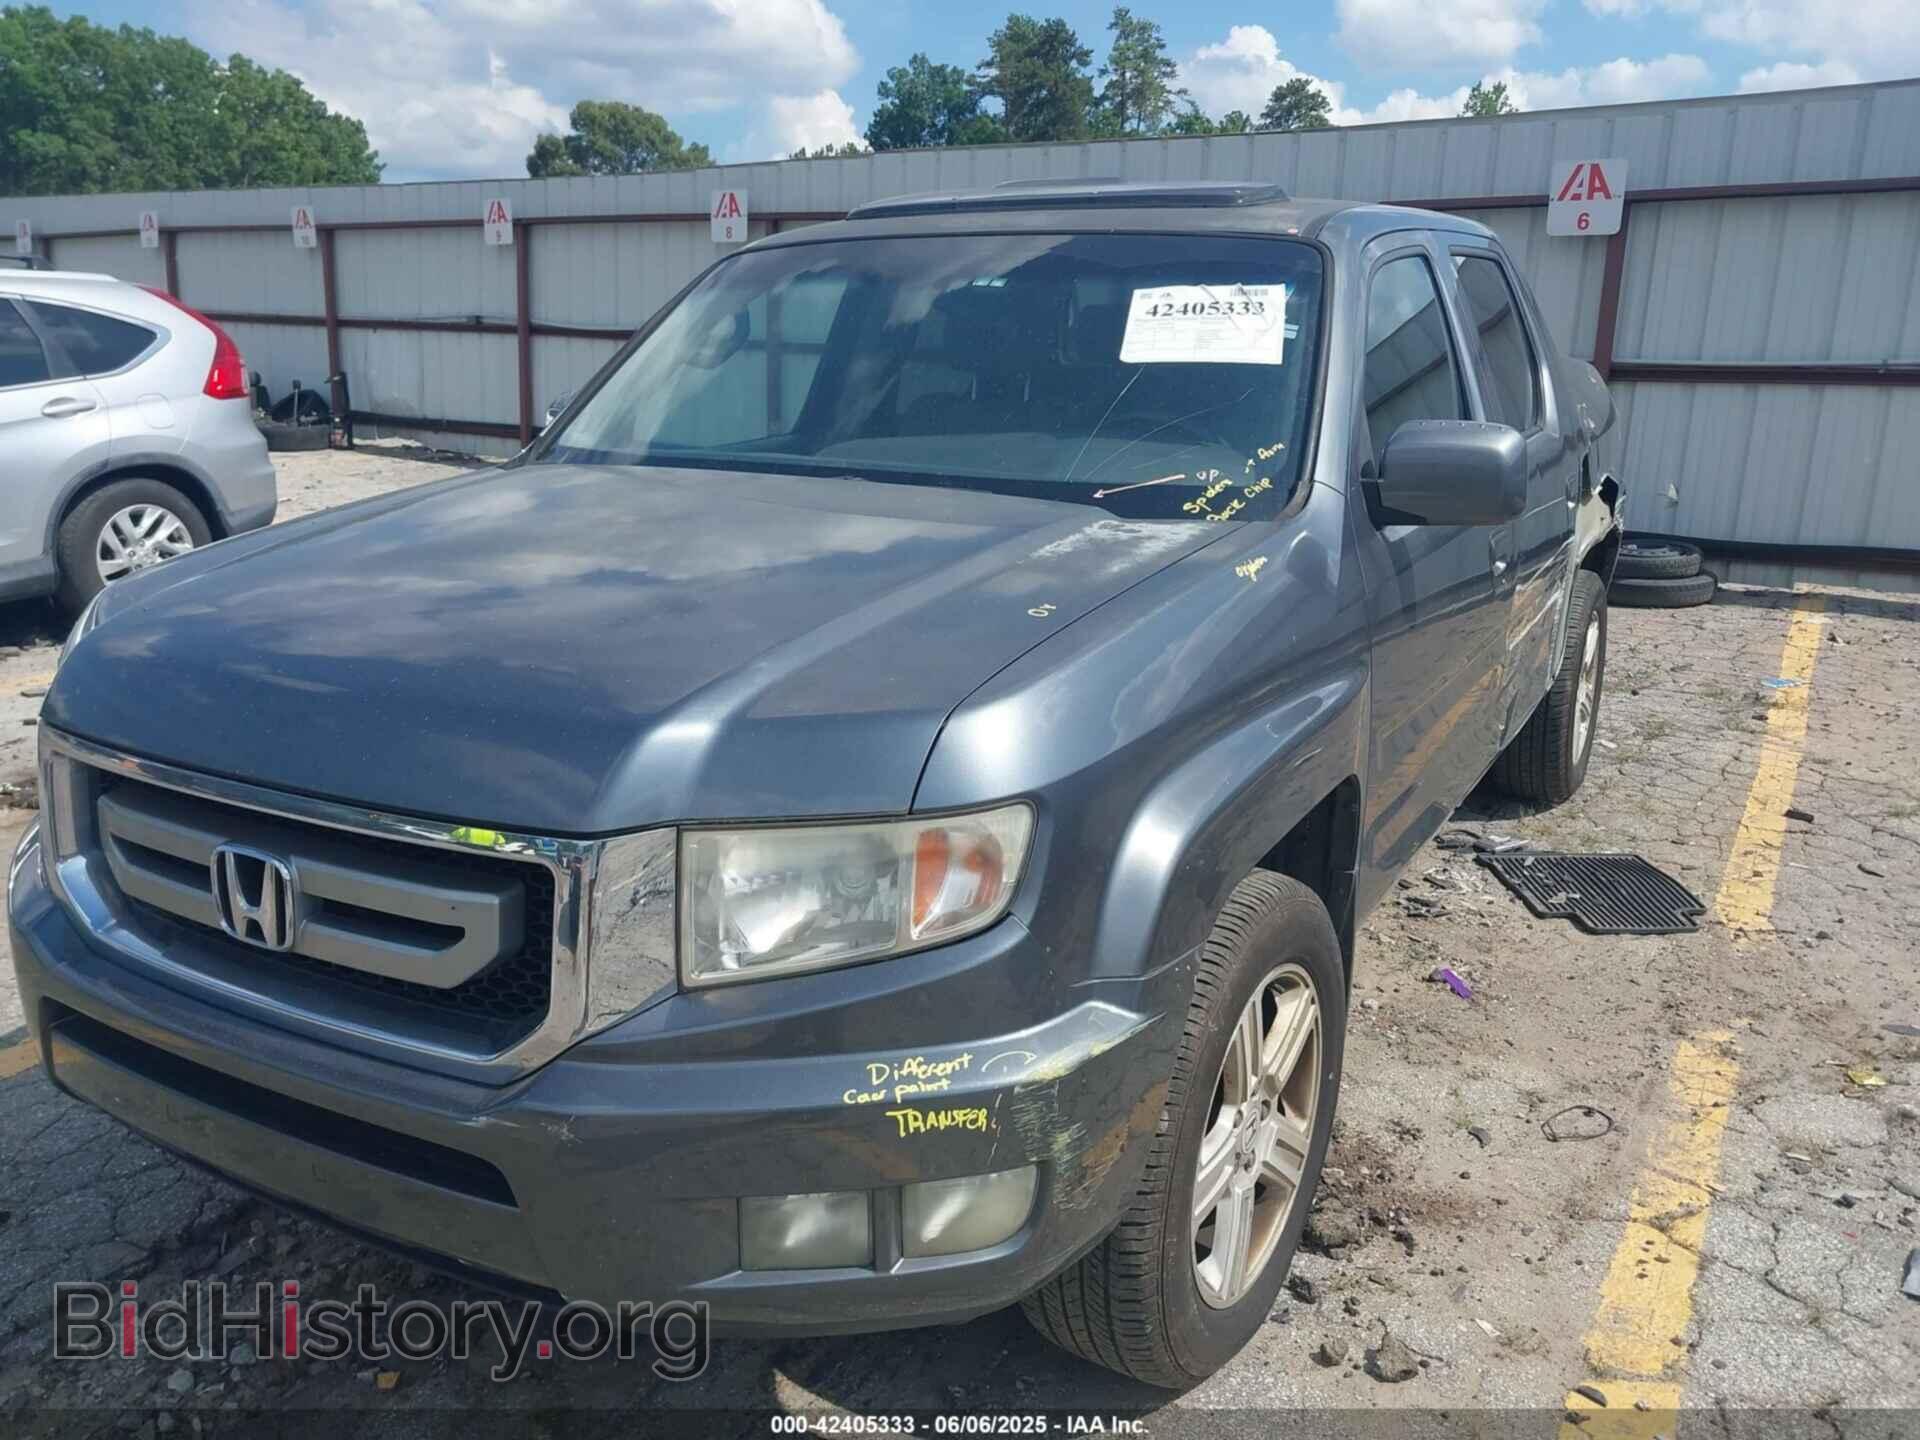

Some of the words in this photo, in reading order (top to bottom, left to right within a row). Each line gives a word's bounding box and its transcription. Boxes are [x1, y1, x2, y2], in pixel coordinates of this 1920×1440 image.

[1577, 212, 1590, 230] 6
[726, 226, 733, 239] 8
[1145, 300, 1266, 317] 42405333
[1243, 477, 1274, 498] Chip
[894, 1078, 951, 1103] paint
[885, 1108, 988, 1138] TRANSFER
